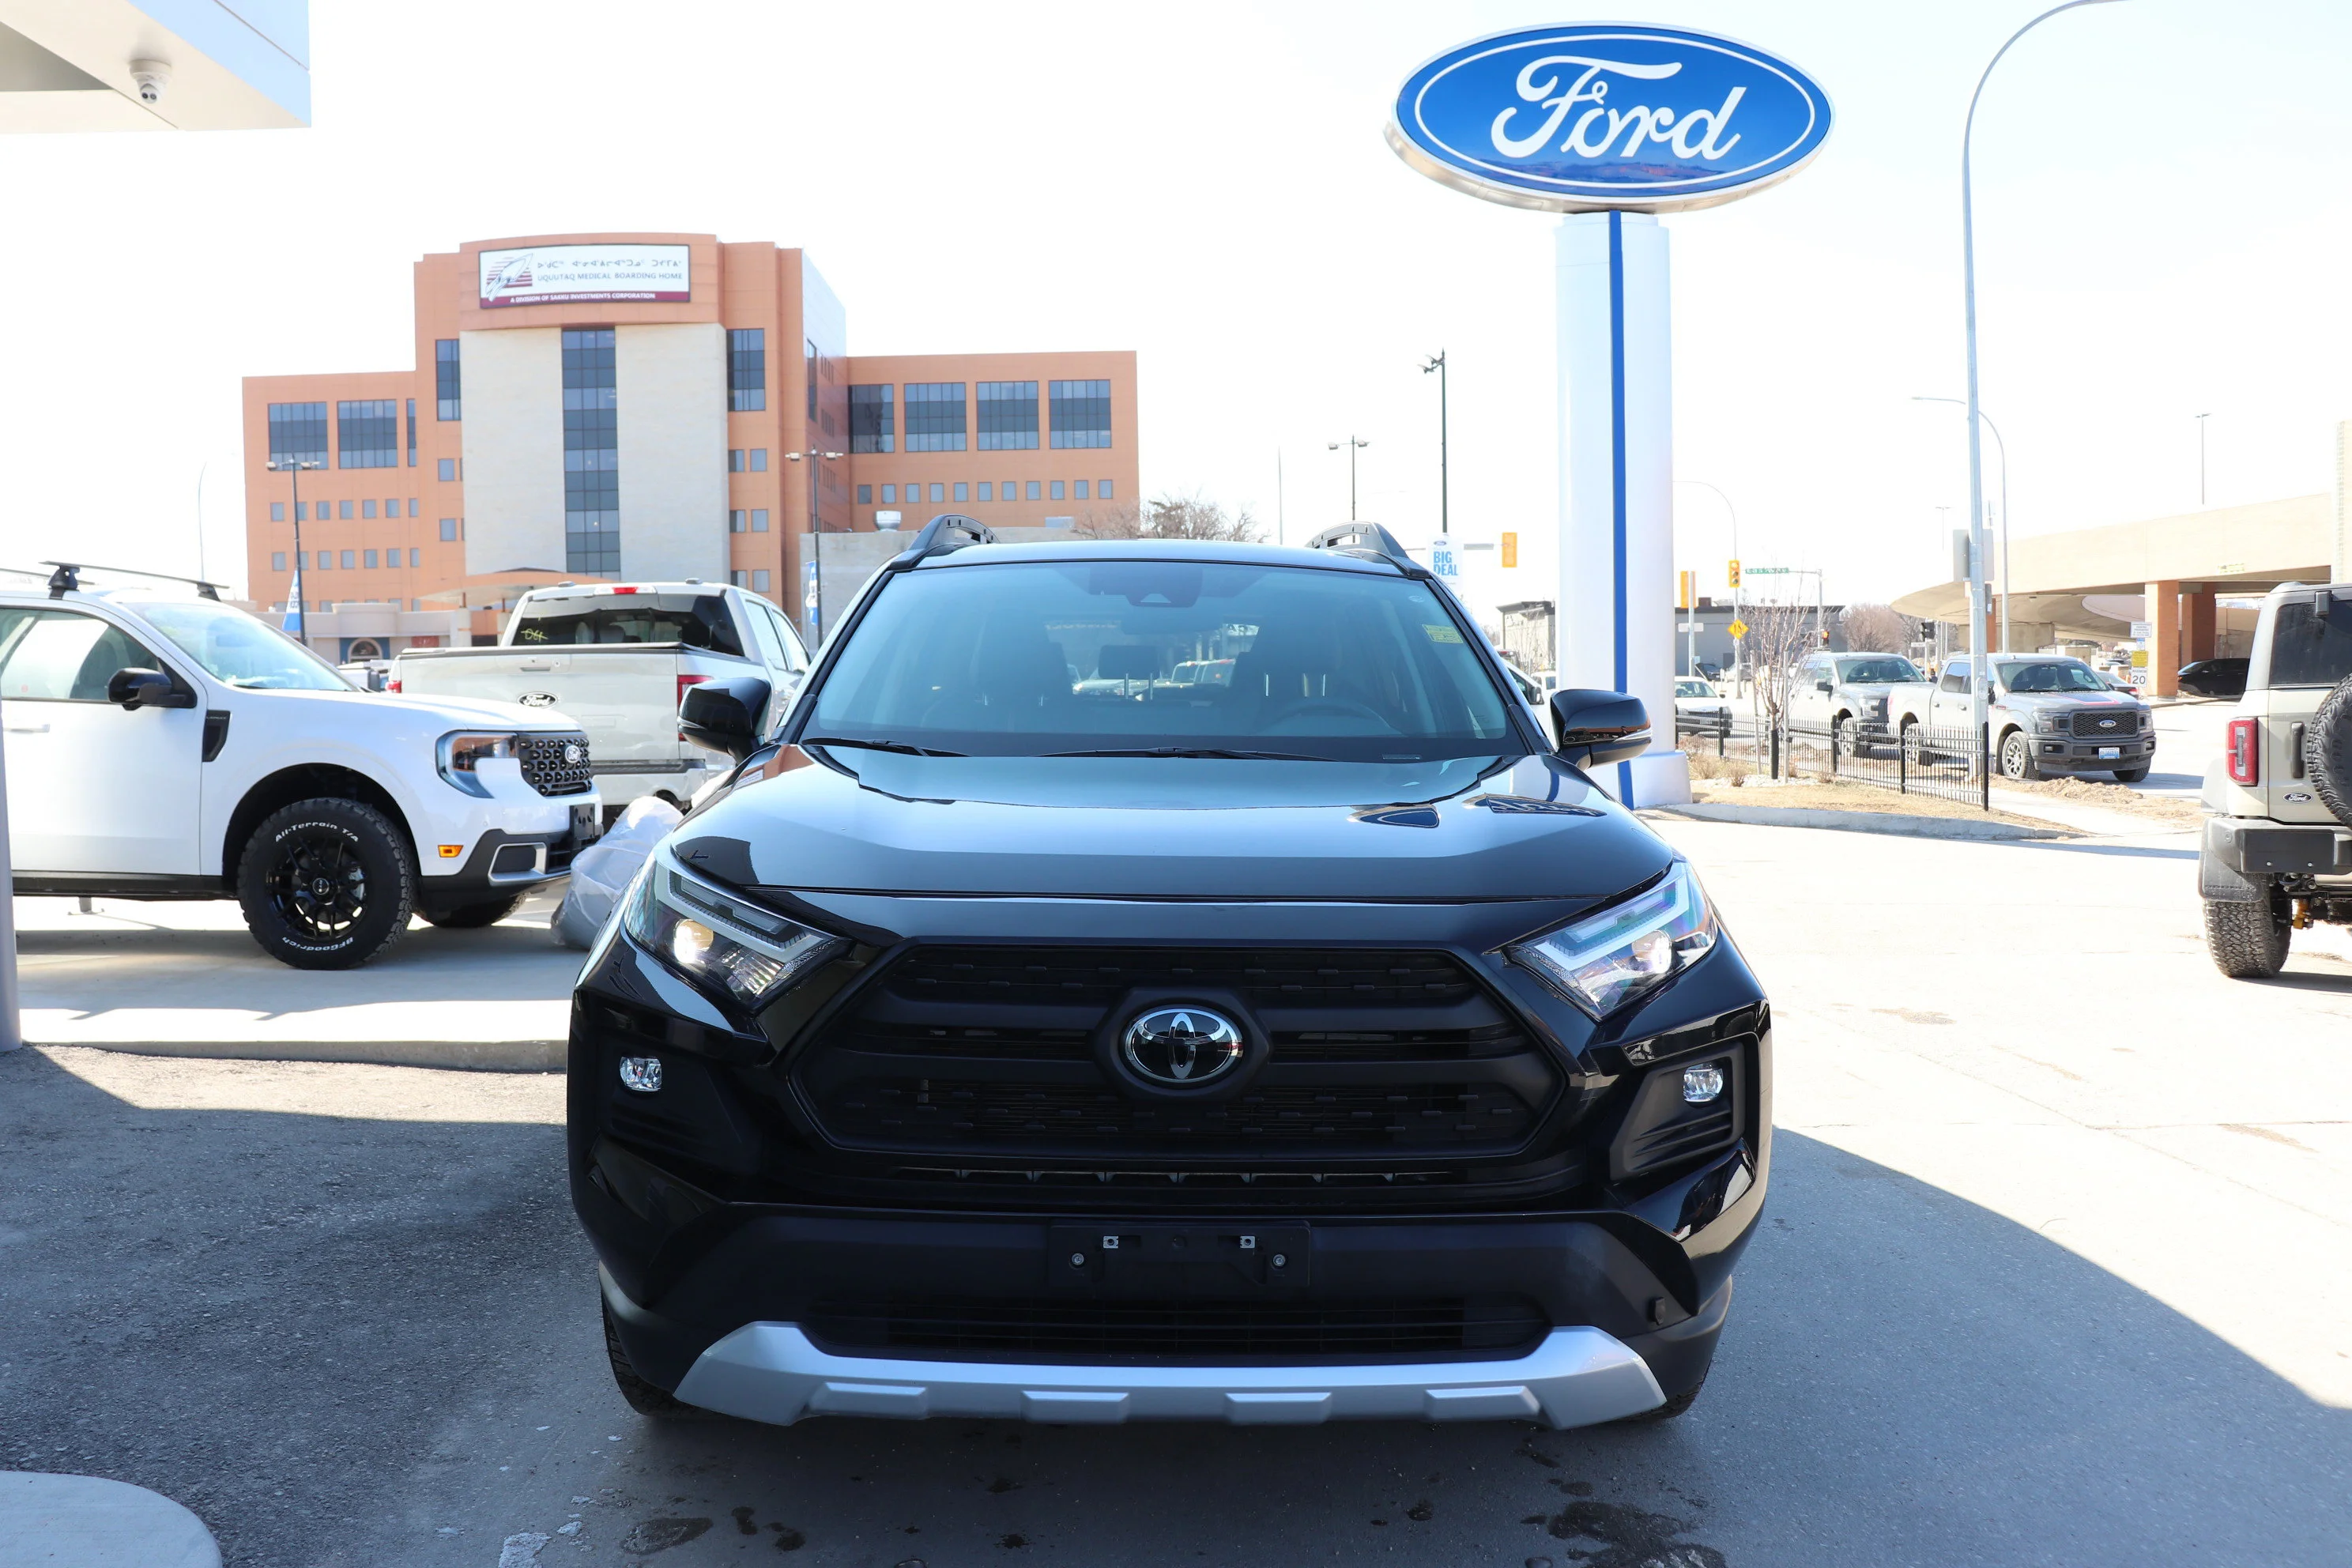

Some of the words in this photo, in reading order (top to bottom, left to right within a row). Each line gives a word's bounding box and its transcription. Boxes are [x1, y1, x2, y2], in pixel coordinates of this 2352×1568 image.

[1491, 55, 1747, 160] Ford
[1433, 551, 1452, 564] BIG
[1433, 564, 1458, 576] DEAL
[2132, 675, 2146, 684] 20
[523, 694, 551, 706] Ford
[275, 821, 337, 842] All-Terrain
[342, 827, 359, 842] T/A
[281, 937, 354, 952] BFGoodrich
